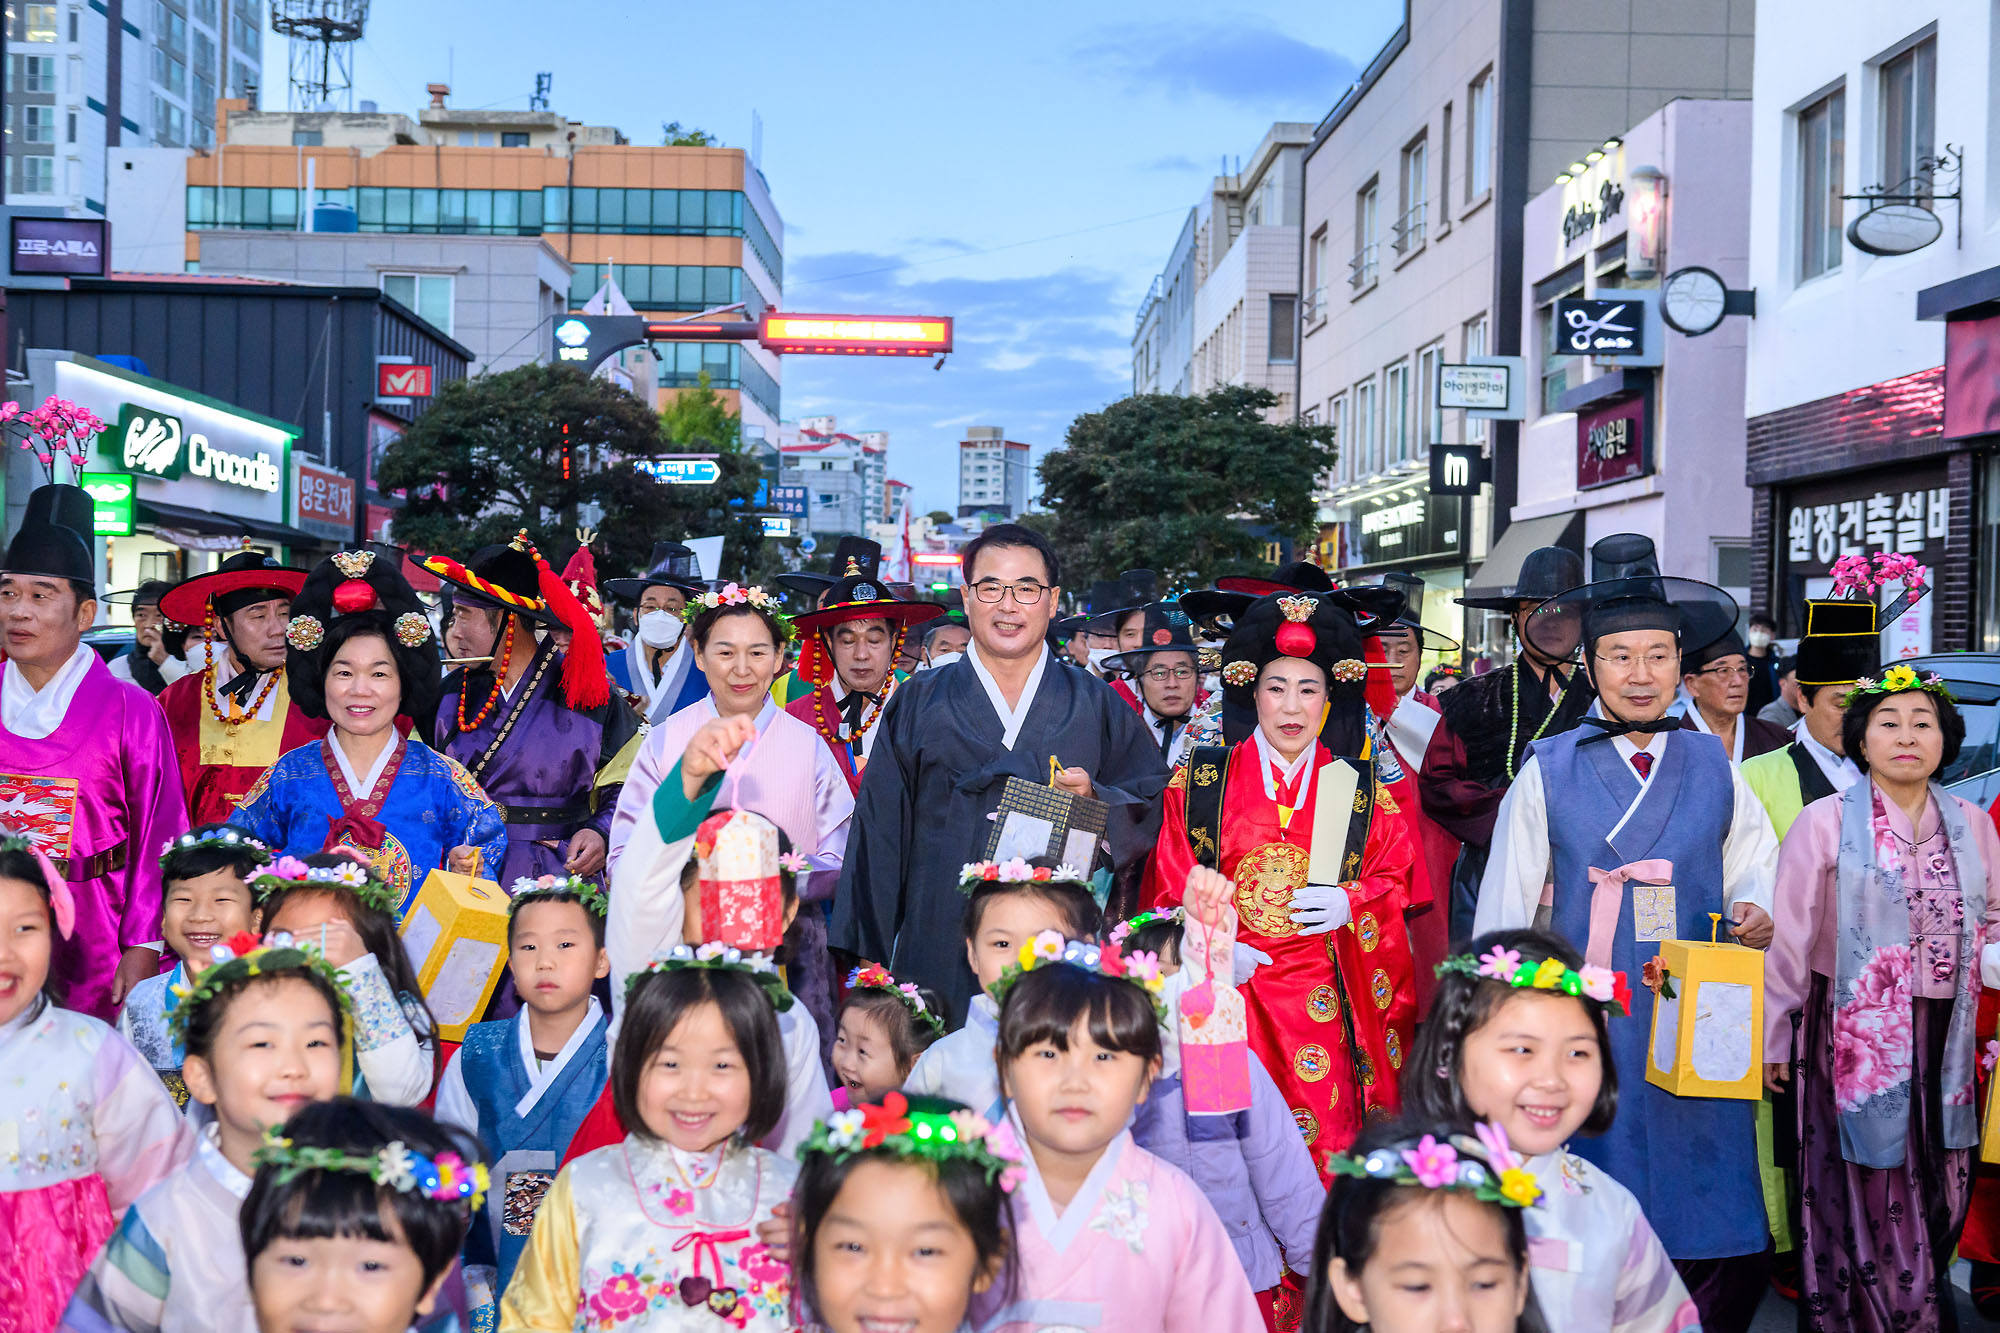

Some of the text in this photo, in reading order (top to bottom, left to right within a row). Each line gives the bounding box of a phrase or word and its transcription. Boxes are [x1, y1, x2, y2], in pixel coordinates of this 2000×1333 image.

[188, 433, 279, 493] Crocodile
[301, 475, 352, 520] 망운전자
[1788, 488, 1950, 564] 원정건축설비
